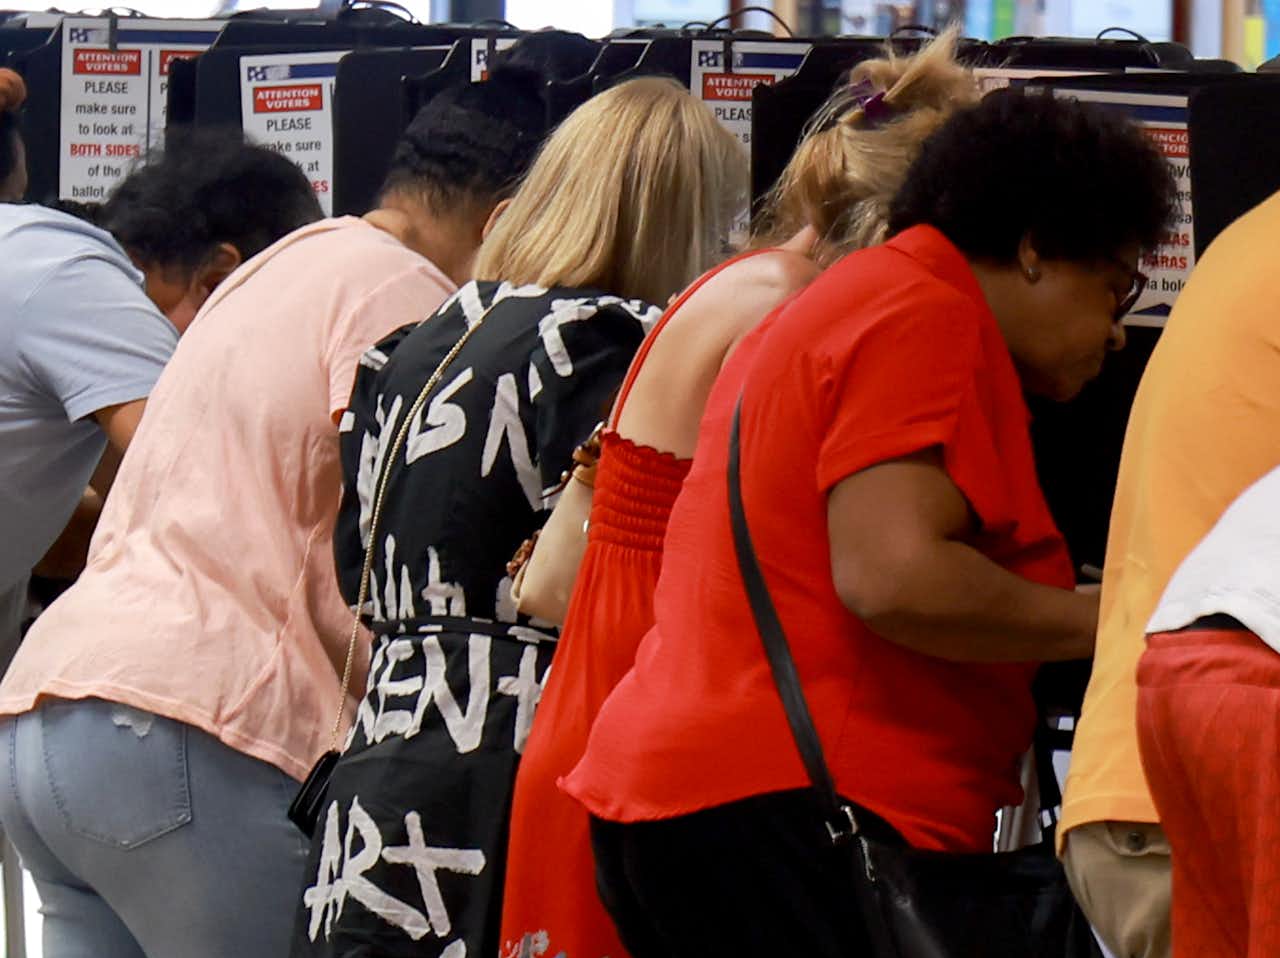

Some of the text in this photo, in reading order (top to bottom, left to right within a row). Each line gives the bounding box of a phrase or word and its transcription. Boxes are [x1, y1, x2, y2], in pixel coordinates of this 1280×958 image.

[77, 53, 138, 62] ATTENTION
[85, 63, 129, 72] VOTERS
[84, 81, 128, 94] PLEASE
[256, 89, 319, 99] ATTENTION
[75, 103, 136, 115] make sure
[266, 99, 310, 109] VOTERS
[715, 107, 752, 121] PLEAS
[78, 124, 134, 136] to look at
[266, 117, 312, 132] PLEASE
[70, 144, 140, 157] BOTH SIDES
[295, 141, 322, 151] sure
[87, 165, 121, 177] of the
[307, 161, 320, 171] at
[72, 186, 104, 197] ballot
